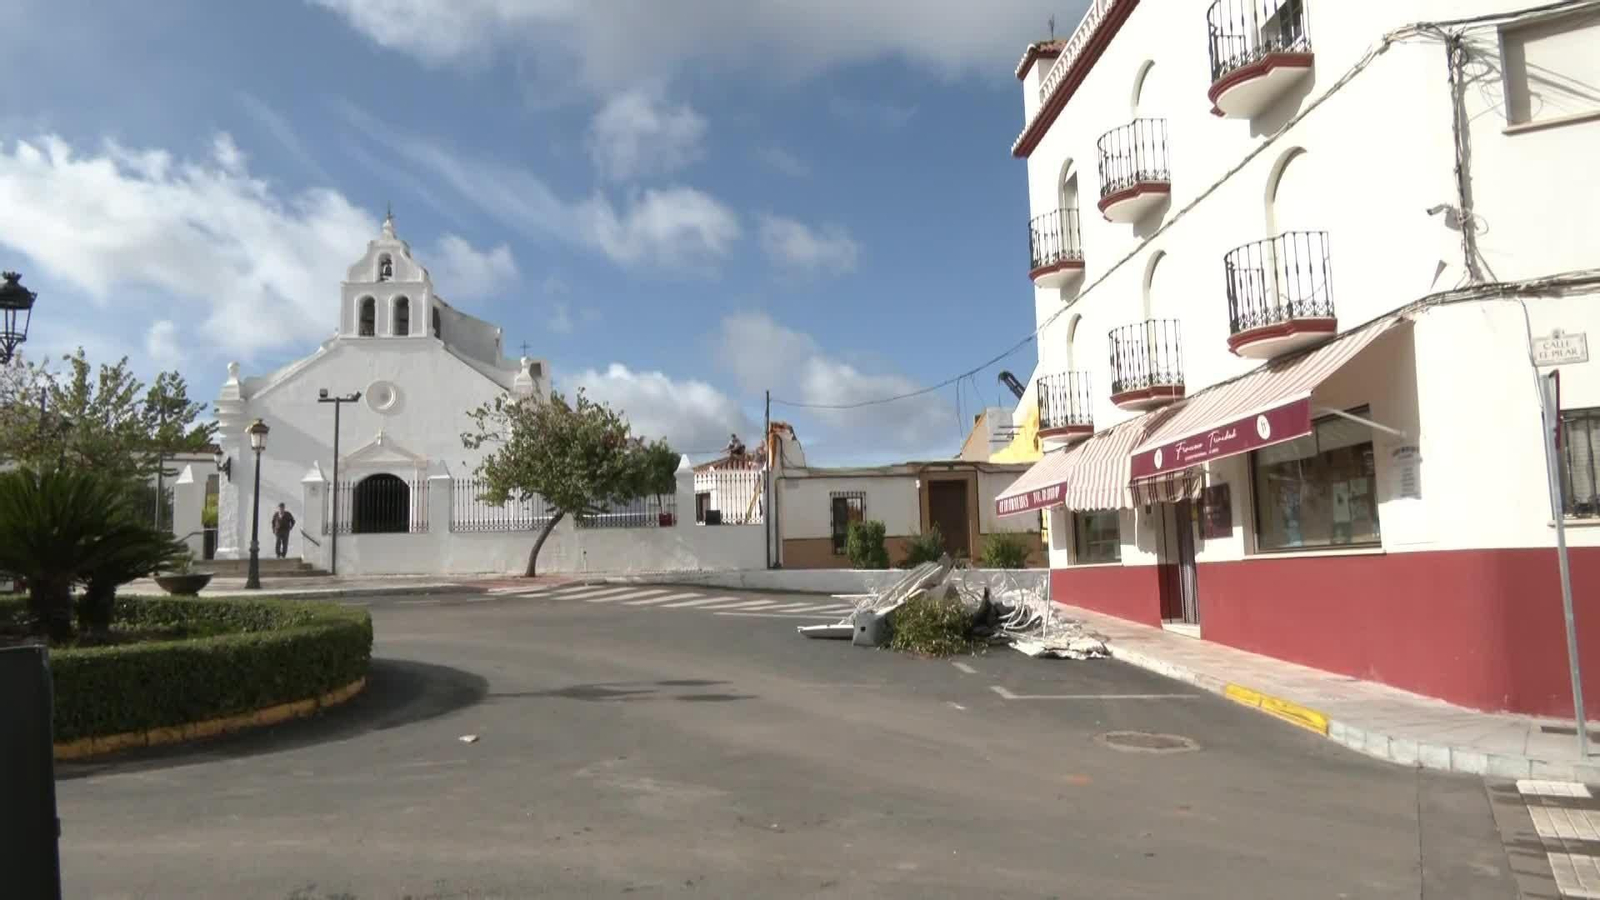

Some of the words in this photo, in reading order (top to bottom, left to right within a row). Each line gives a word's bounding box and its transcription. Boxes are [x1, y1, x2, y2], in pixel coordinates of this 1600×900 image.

[1543, 340, 1570, 350] CALLE
[1539, 351, 1548, 359] EL
[1552, 347, 1578, 357] PILAR
